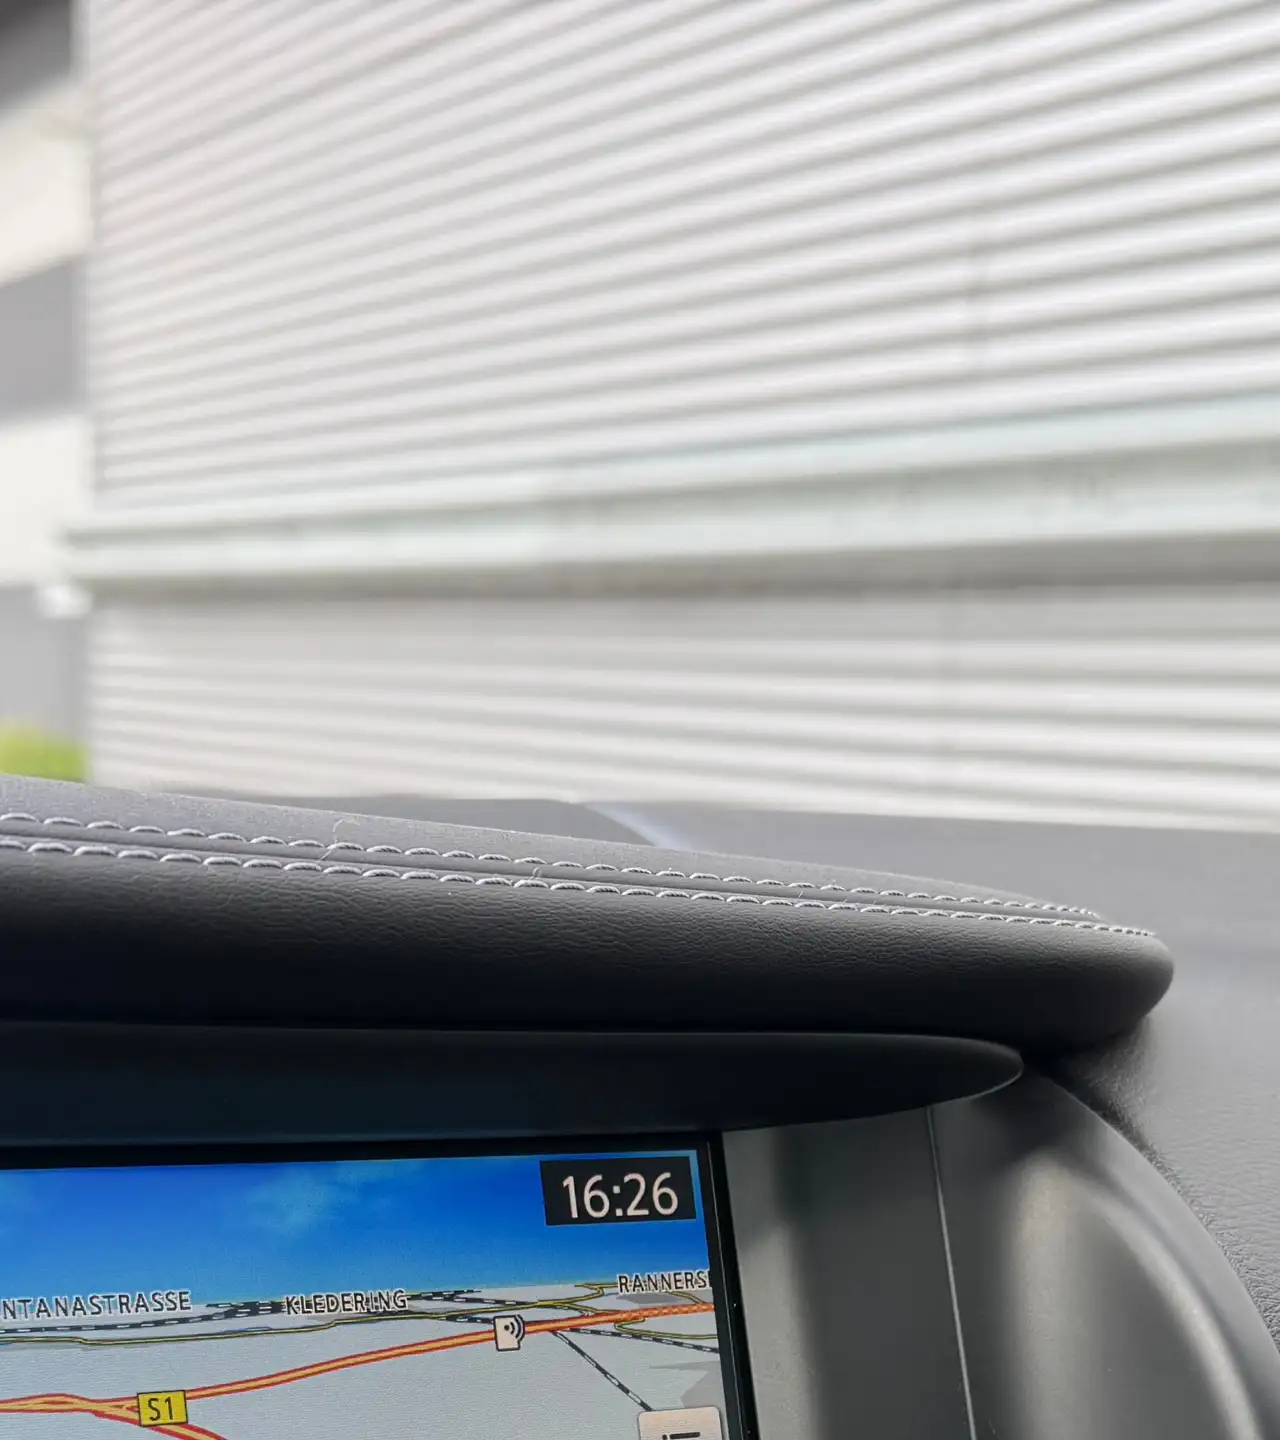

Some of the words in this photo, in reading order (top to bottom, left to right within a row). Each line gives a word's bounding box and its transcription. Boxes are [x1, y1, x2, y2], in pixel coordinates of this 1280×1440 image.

[562, 1172, 680, 1220] 16:26
[285, 1288, 409, 1316] KLEDERING
[147, 1396, 175, 1421] S1
